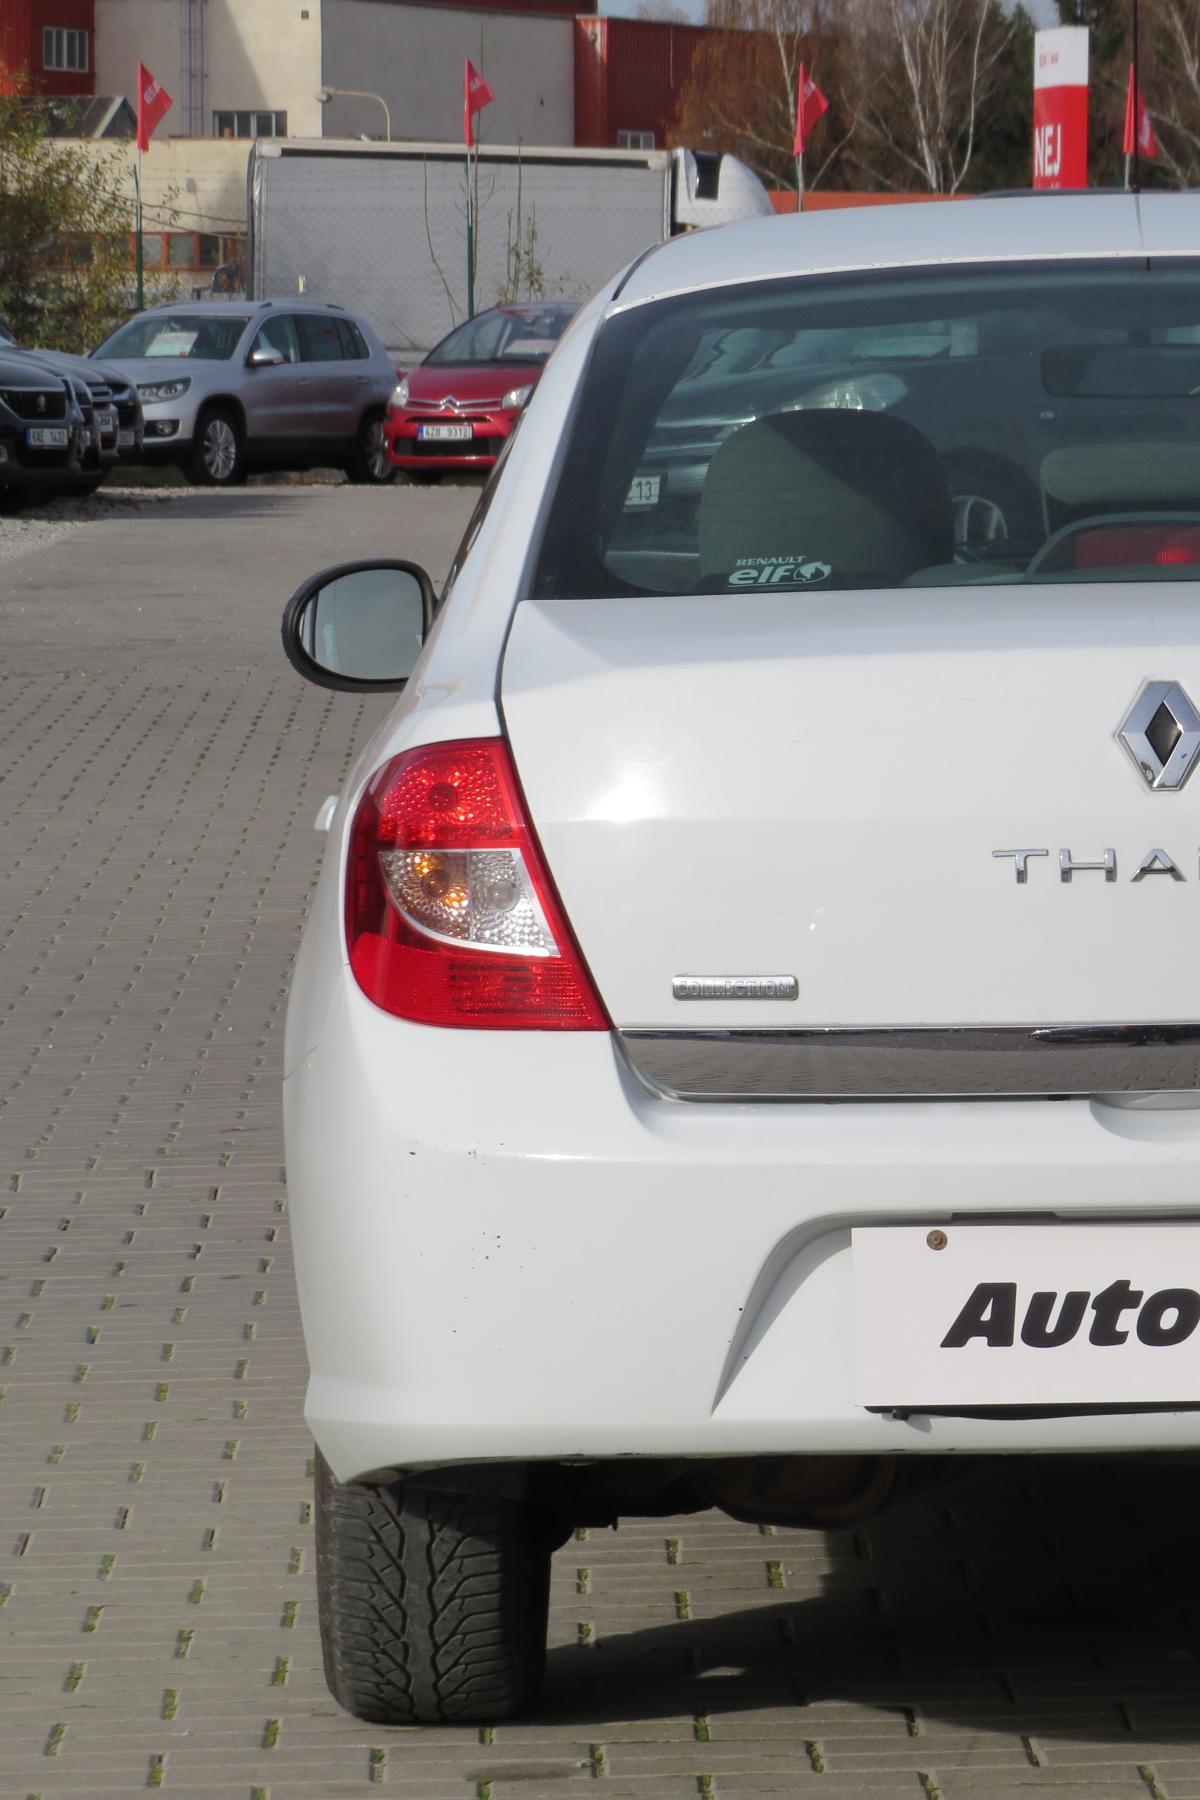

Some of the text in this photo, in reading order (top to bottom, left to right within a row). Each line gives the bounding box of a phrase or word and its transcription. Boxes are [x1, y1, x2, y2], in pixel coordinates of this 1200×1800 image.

[1034, 123, 1061, 177] NEJ
[736, 555, 807, 567] RENAULT
[728, 565, 795, 585] elf
